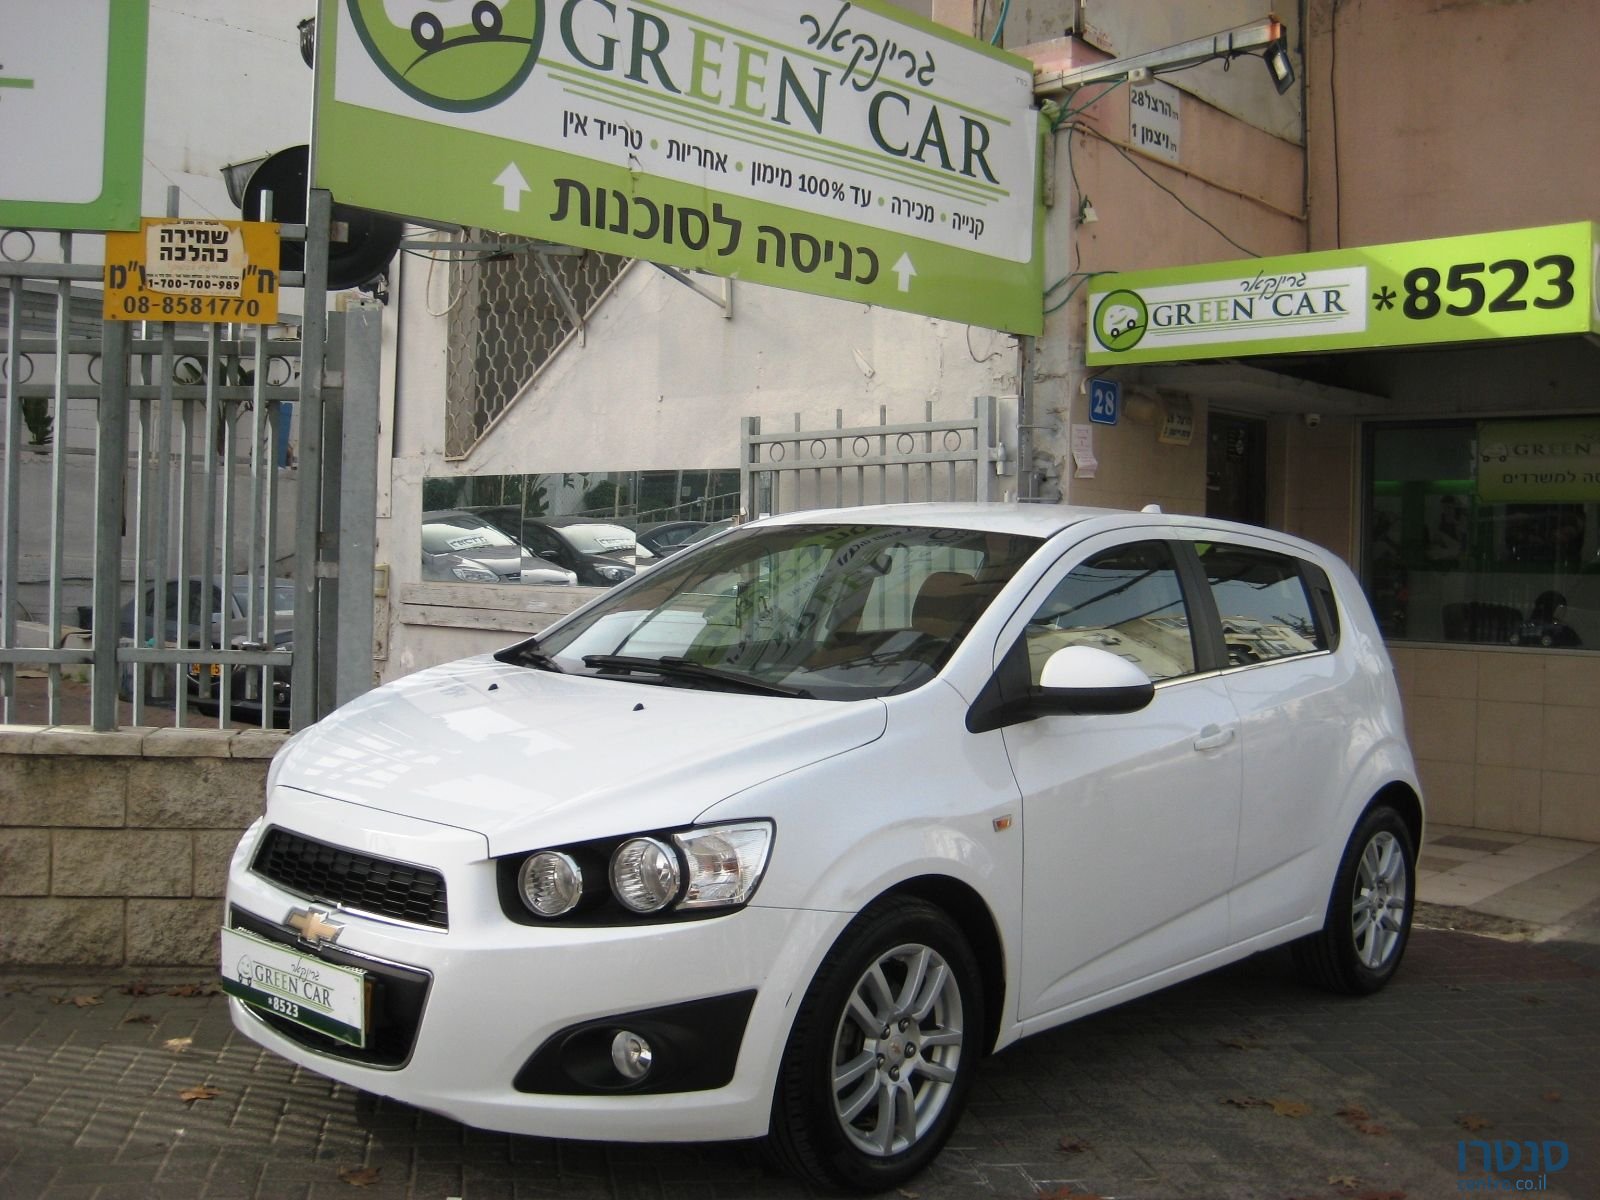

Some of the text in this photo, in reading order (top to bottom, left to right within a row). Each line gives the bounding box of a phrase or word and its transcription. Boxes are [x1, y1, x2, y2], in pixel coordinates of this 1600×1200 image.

[800, 2, 936, 92] גרינקאר
[559, 0, 1000, 185] GREEN CAR
[1131, 123, 1137, 137] 1
[1141, 126, 1170, 149] ויצמן
[563, 110, 985, 240] קנייה מכירה עד 100% מימון אחריות טרייד אין
[159, 228, 229, 245] שמירה
[549, 178, 880, 285] כניסה לסוכנות
[159, 244, 229, 263] כהלכה
[148, 278, 240, 290] 1-700-700-989
[1240, 270, 1307, 300] גרינקאר
[123, 295, 260, 317] 08-8581770
[1152, 289, 1347, 327] GREEN CAR
[1094, 388, 1115, 416] 28
[254, 964, 332, 1008] GREEN CAR
